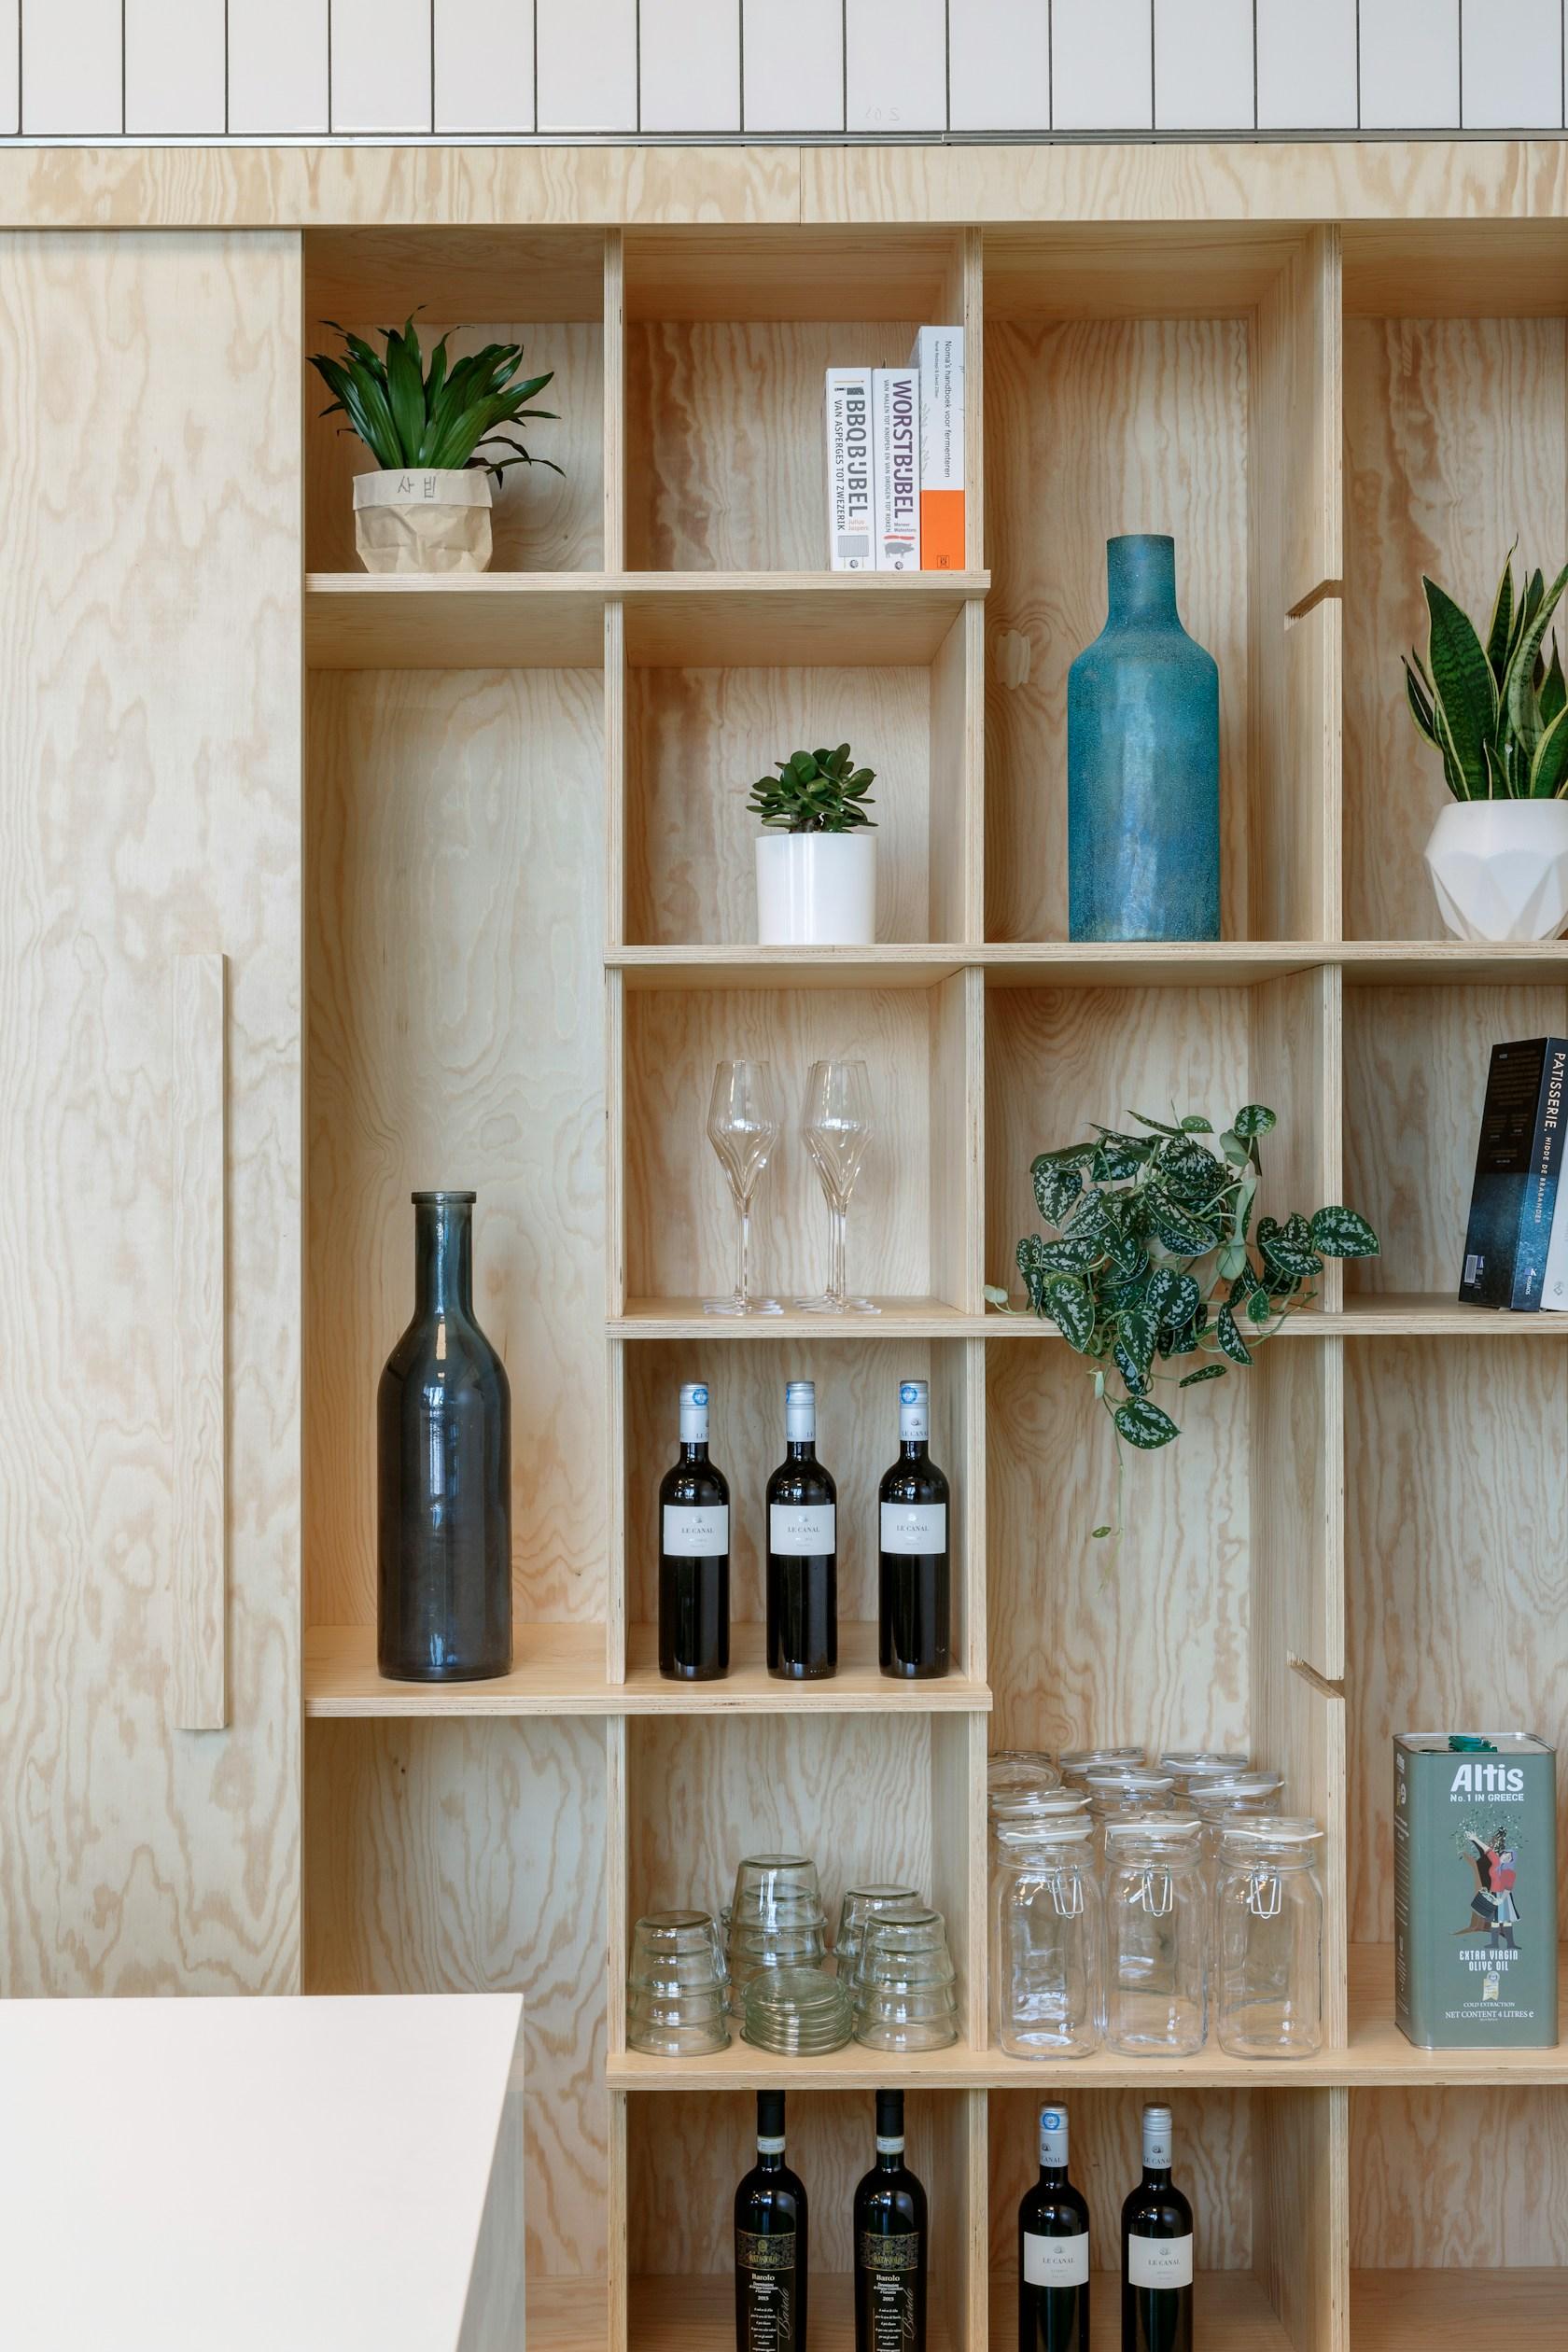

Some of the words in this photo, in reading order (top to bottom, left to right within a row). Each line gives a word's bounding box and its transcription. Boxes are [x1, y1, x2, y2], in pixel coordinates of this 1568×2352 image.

[834, 399, 843, 417] VAN
[835, 421, 844, 465] ASPERGES
[836, 485, 845, 530] ZWEZERIK
[1544, 1052, 1566, 1132] PATISSERIE.
[1543, 1137, 1552, 1161] HIDDE
[1540, 1164, 1548, 1174] DE
[1450, 1763, 1524, 1792] Altis
[1488, 1793, 1524, 1801] GREECE
[1460, 1950, 1486, 1960] EXTRA
[1490, 1950, 1519, 1960] VIRGIN
[1469, 1961, 1492, 1971] OLIVE
[1496, 1961, 1509, 1971] OIL
[1504, 2009, 1528, 2018] LITRES
[752, 2273, 775, 2281] Barolo
[876, 2274, 901, 2282] Barolo
